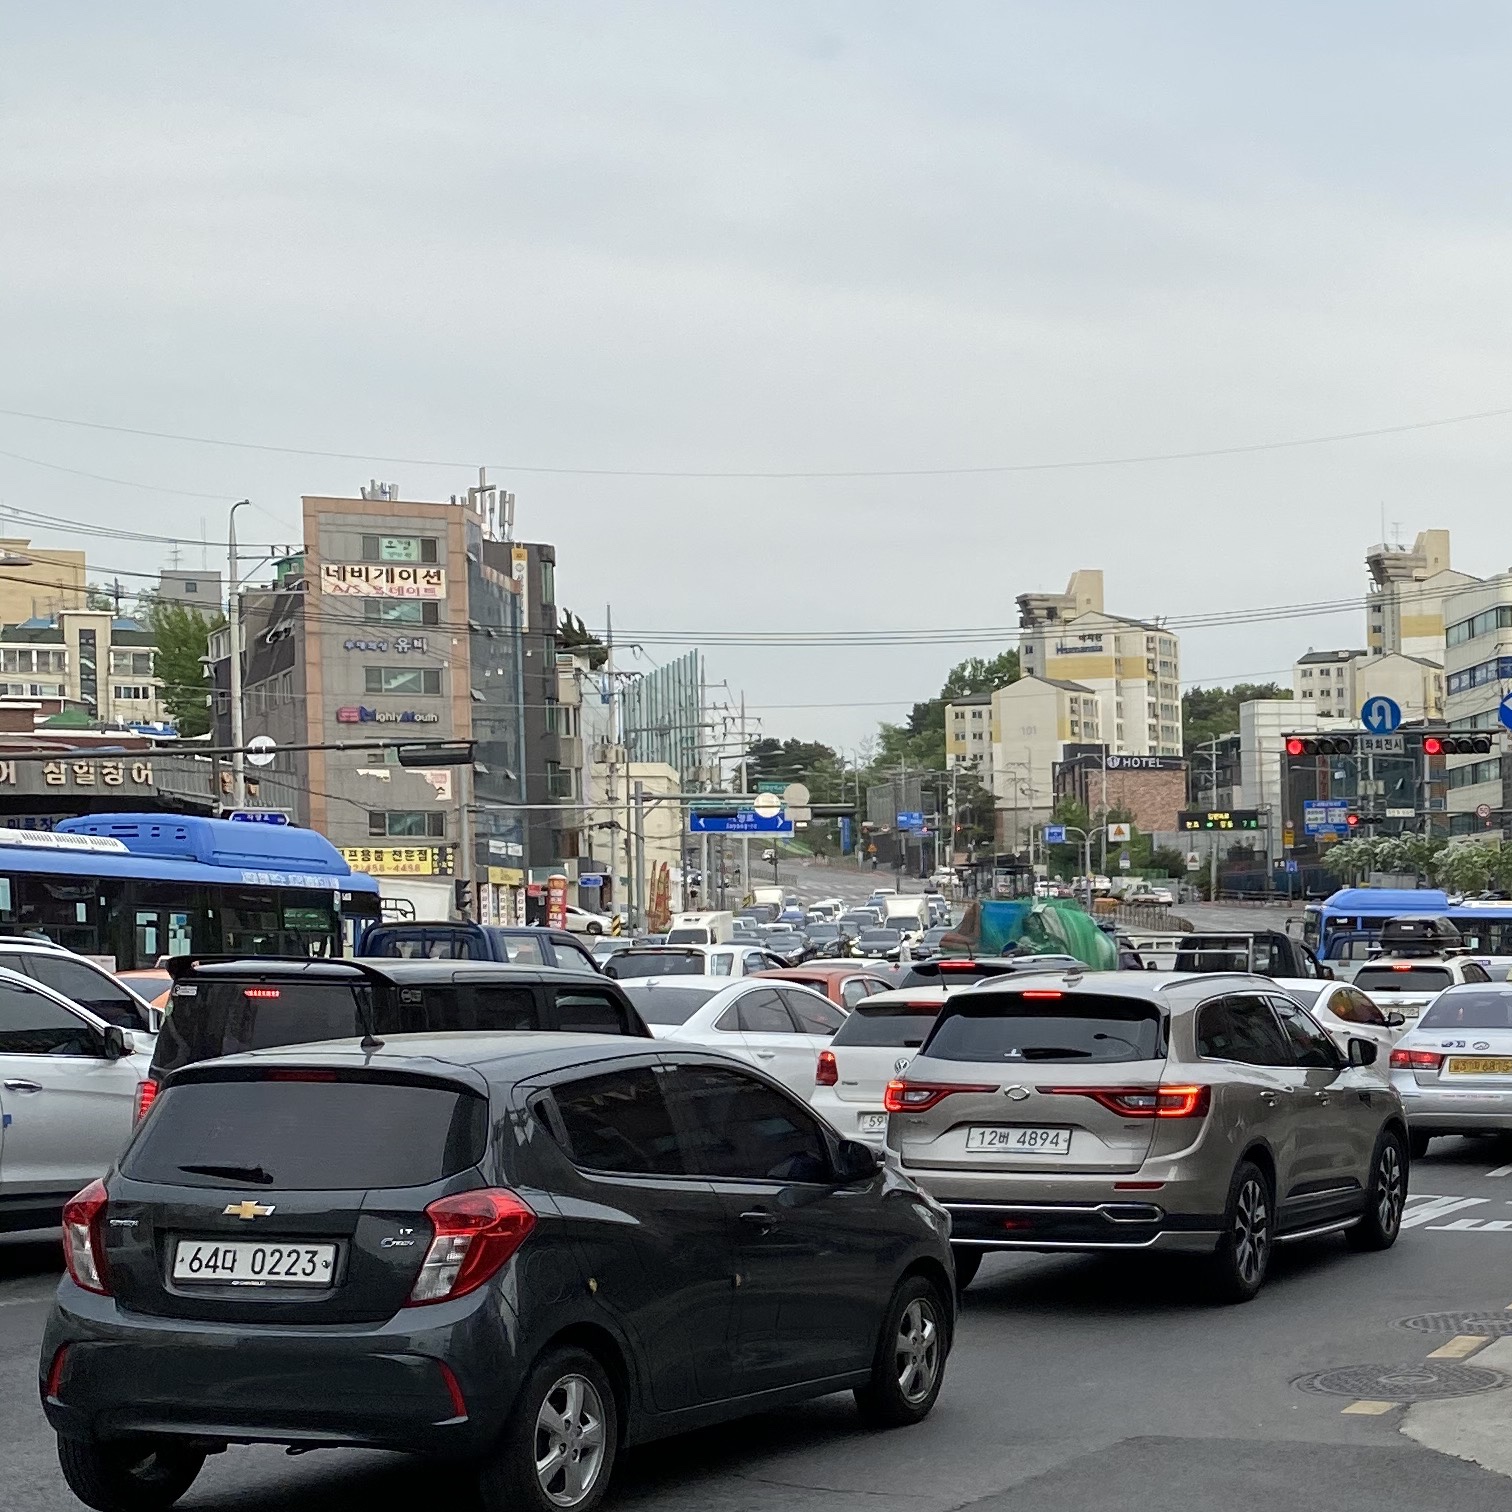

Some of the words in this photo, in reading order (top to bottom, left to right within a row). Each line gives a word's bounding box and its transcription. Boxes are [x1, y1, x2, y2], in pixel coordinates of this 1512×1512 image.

[326, 566, 442, 585] 네비게이션
[1365, 738, 1401, 750] 좌회전시
[1122, 758, 1164, 768] HOTEL
[43, 760, 154, 786] 삼일장어
[1017, 1131, 1060, 1147] 4894
[250, 1248, 319, 1276] 0223
